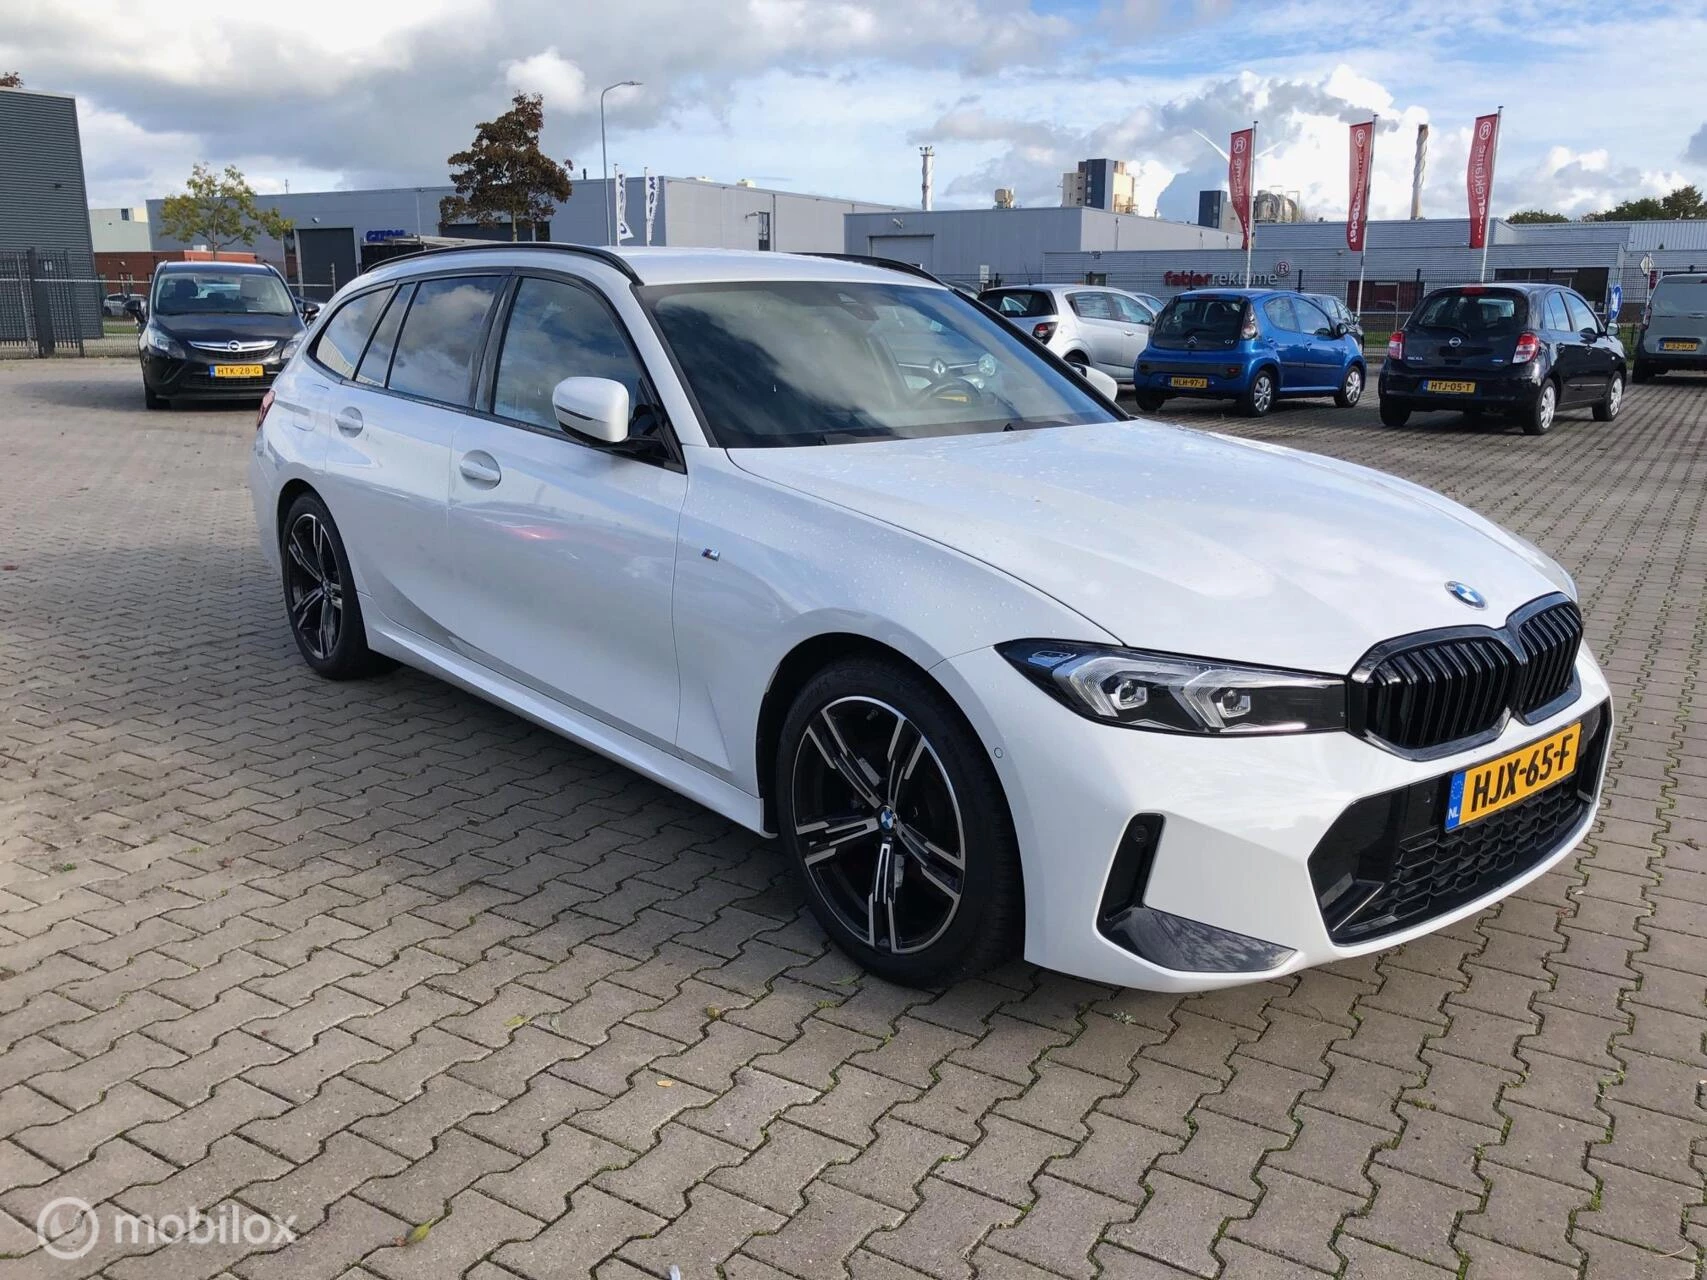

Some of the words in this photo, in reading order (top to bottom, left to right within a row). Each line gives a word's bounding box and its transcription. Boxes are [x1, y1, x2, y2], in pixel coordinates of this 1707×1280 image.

[217, 366, 260, 375] HTK-28-G
[1431, 382, 1472, 392] HTJ-05-T
[1471, 733, 1573, 812] HJX-65-F
[1448, 807, 1459, 820] NL
